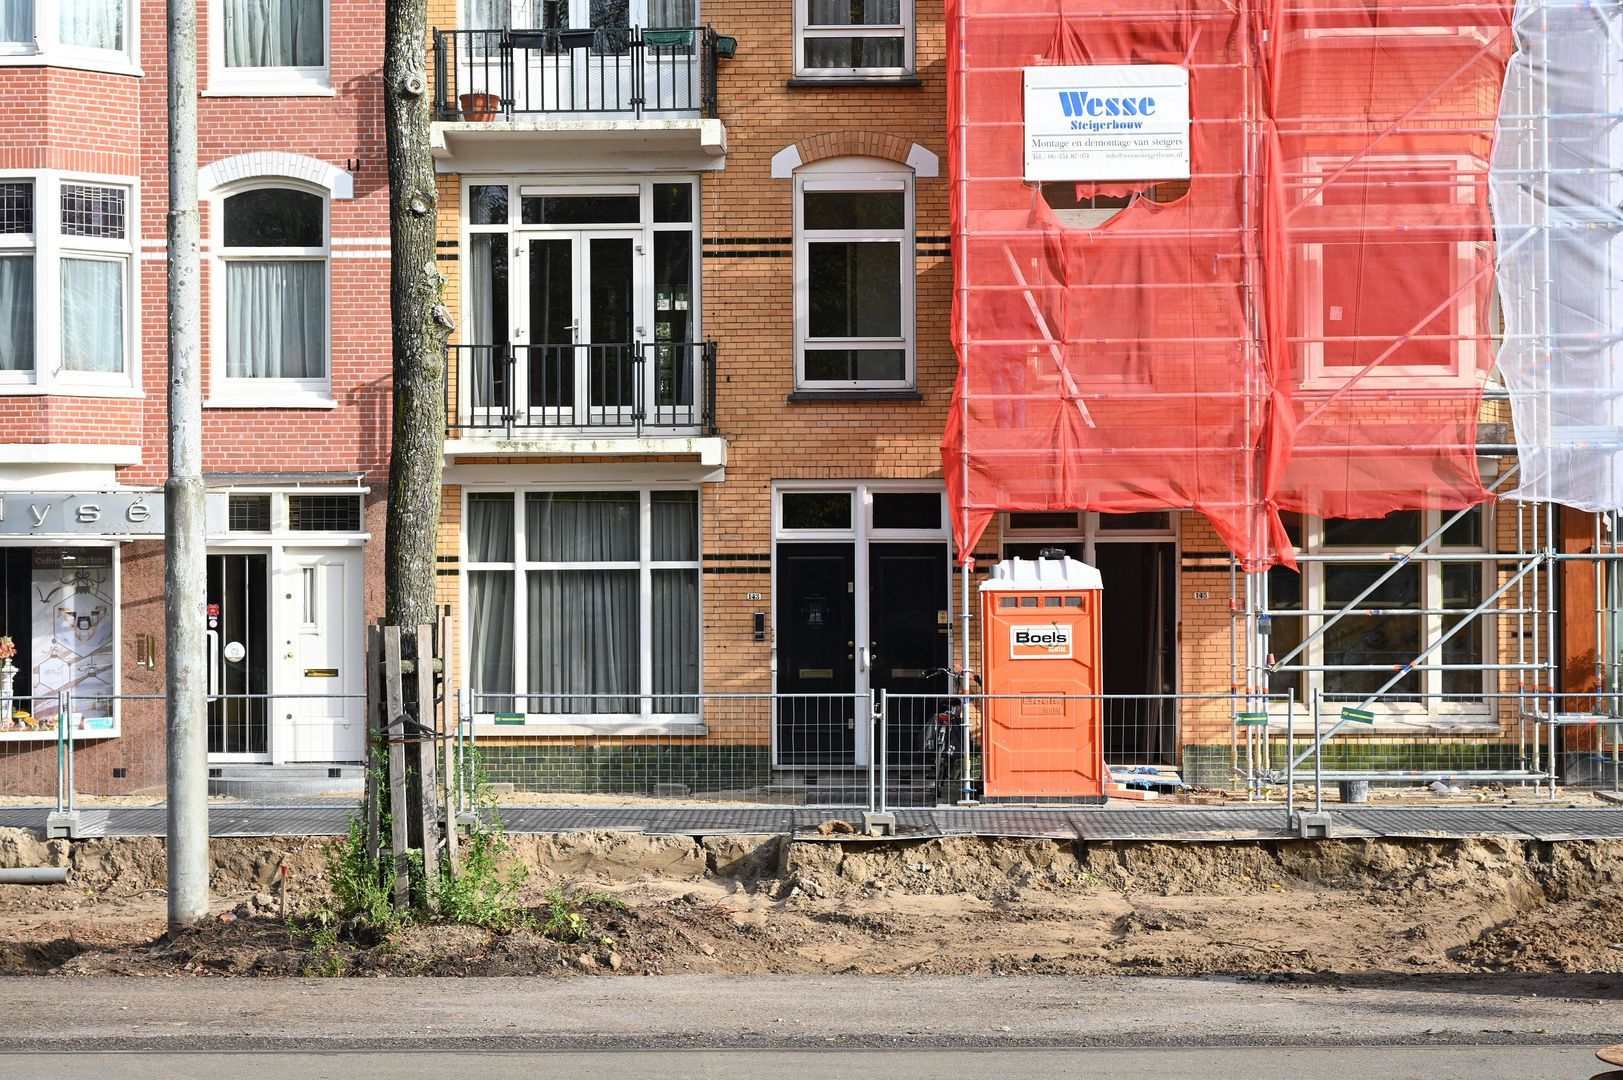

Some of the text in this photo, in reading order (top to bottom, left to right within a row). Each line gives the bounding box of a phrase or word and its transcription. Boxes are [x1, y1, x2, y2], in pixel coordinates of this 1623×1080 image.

[1058, 91, 1156, 117] Wesse
[1070, 120, 1143, 132] Steigerbouw
[1032, 139, 1069, 149] Montage
[1085, 138, 1131, 148] demontage
[1152, 138, 1183, 148] steigers
[1016, 632, 1067, 643] Boels
